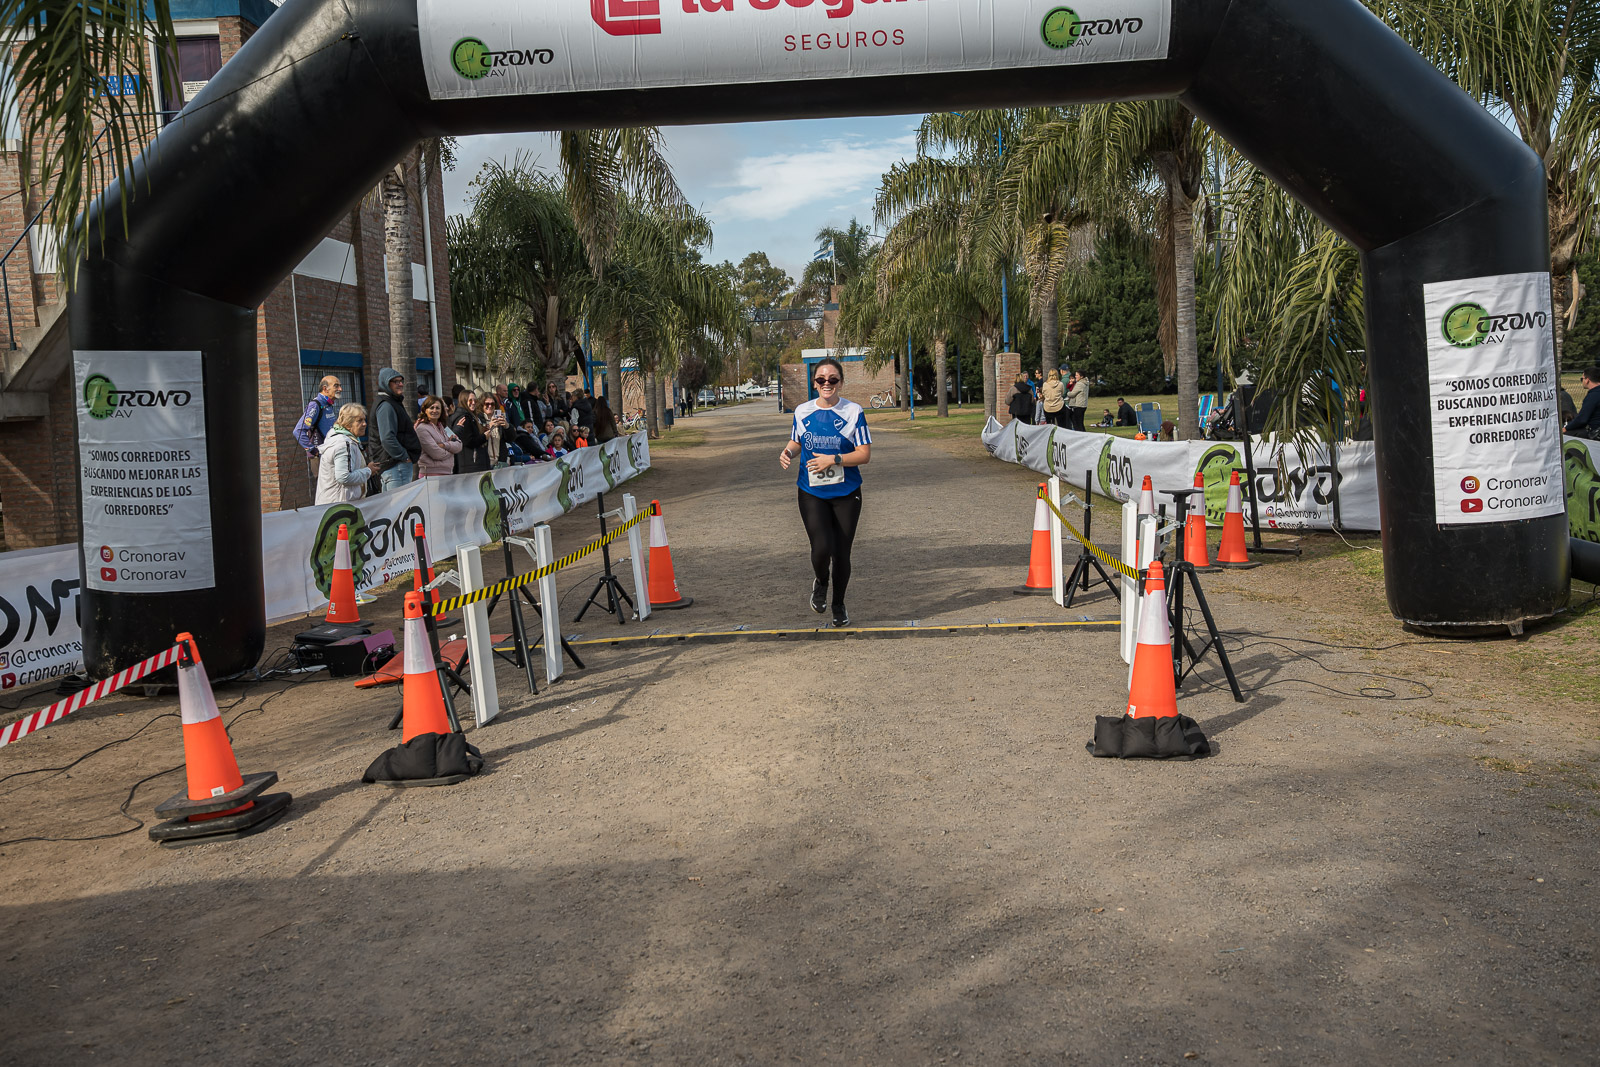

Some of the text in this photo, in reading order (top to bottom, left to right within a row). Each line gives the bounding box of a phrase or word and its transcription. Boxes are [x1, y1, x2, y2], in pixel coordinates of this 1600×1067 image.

[1069, 17, 1143, 36] CRONO
[783, 29, 905, 51] SEGUROS
[1066, 38, 1093, 47] RAV
[480, 49, 554, 67] CRONO
[480, 68, 506, 78] RAV
[1476, 311, 1547, 333] CRONO
[1474, 334, 1506, 345] RAV
[1492, 372, 1548, 389] CORREDORES
[106, 390, 192, 407] CRONO
[1437, 389, 1554, 411] BUSCANDO MEJORAR LAS
[105, 409, 133, 419] RAV
[1449, 407, 1550, 428] EXPERIENCIAS DE LOS
[804, 431, 814, 450] 3
[121, 450, 191, 462] CORREDORES
[84, 467, 201, 481] BUSCANDO MEJORAR LAS
[1487, 475, 1548, 491] Cronorav
[90, 485, 192, 498] EXPERIENCIAS DE LOS
[1487, 494, 1549, 510] Cronorav
[119, 549, 186, 563] Cronorav
[120, 568, 187, 582] Cronorav
[19, 659, 79, 686] cronorav
